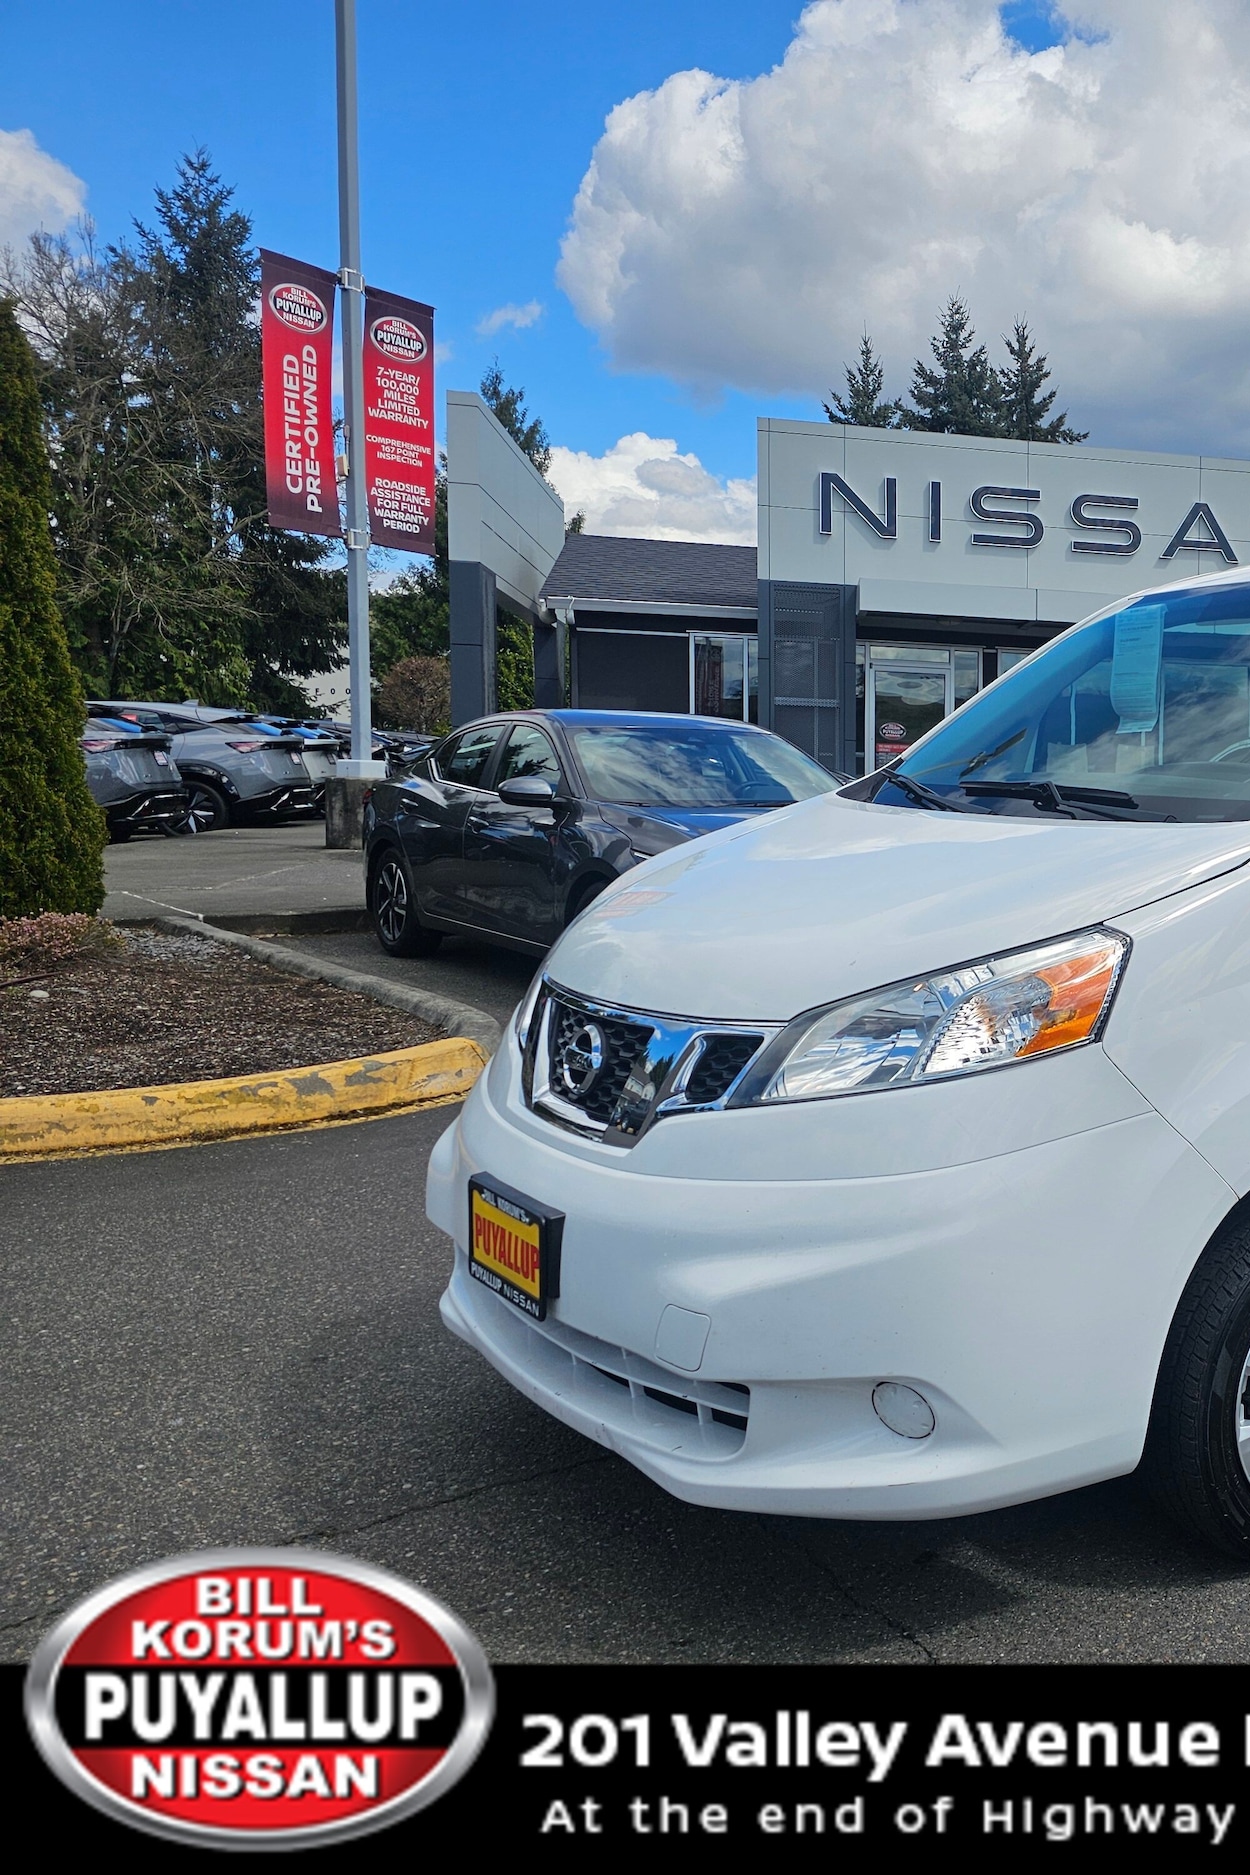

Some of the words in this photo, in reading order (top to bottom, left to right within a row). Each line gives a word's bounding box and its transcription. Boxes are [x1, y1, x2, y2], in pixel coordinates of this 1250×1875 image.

[282, 291, 316, 308] KORUM'S
[291, 287, 308, 298] BILL
[276, 297, 322, 322] PUYALLUP
[282, 312, 315, 329] NISSAN
[391, 320, 408, 330] BILL
[377, 330, 422, 352] PUYALLUP
[383, 324, 417, 339] KORUM'S
[383, 343, 415, 358] NISSAN
[376, 366, 420, 386] 7-YEAR/
[375, 376, 420, 396] 100,000
[383, 389, 416, 405] MILES
[378, 398, 420, 416] LIMITED
[283, 354, 303, 494] CERTIFIED
[367, 406, 429, 429] WARRANTY
[302, 344, 323, 513] PRE-OWNED
[365, 434, 432, 455] COMPREHENSIVE
[396, 448, 420, 459] POINT
[376, 451, 423, 467] INSPECTION
[375, 477, 426, 496] ROADSIDE
[370, 487, 431, 507] ASSISTANCE
[377, 498, 400, 510] FOR
[401, 502, 424, 515] FULL
[374, 507, 430, 526] WARRANTY
[382, 518, 420, 534] PERIOD
[474, 1213, 540, 1283] PUYALLUP
[470, 1261, 503, 1292] PUYALLUP
[503, 1283, 540, 1317] NISSAN
